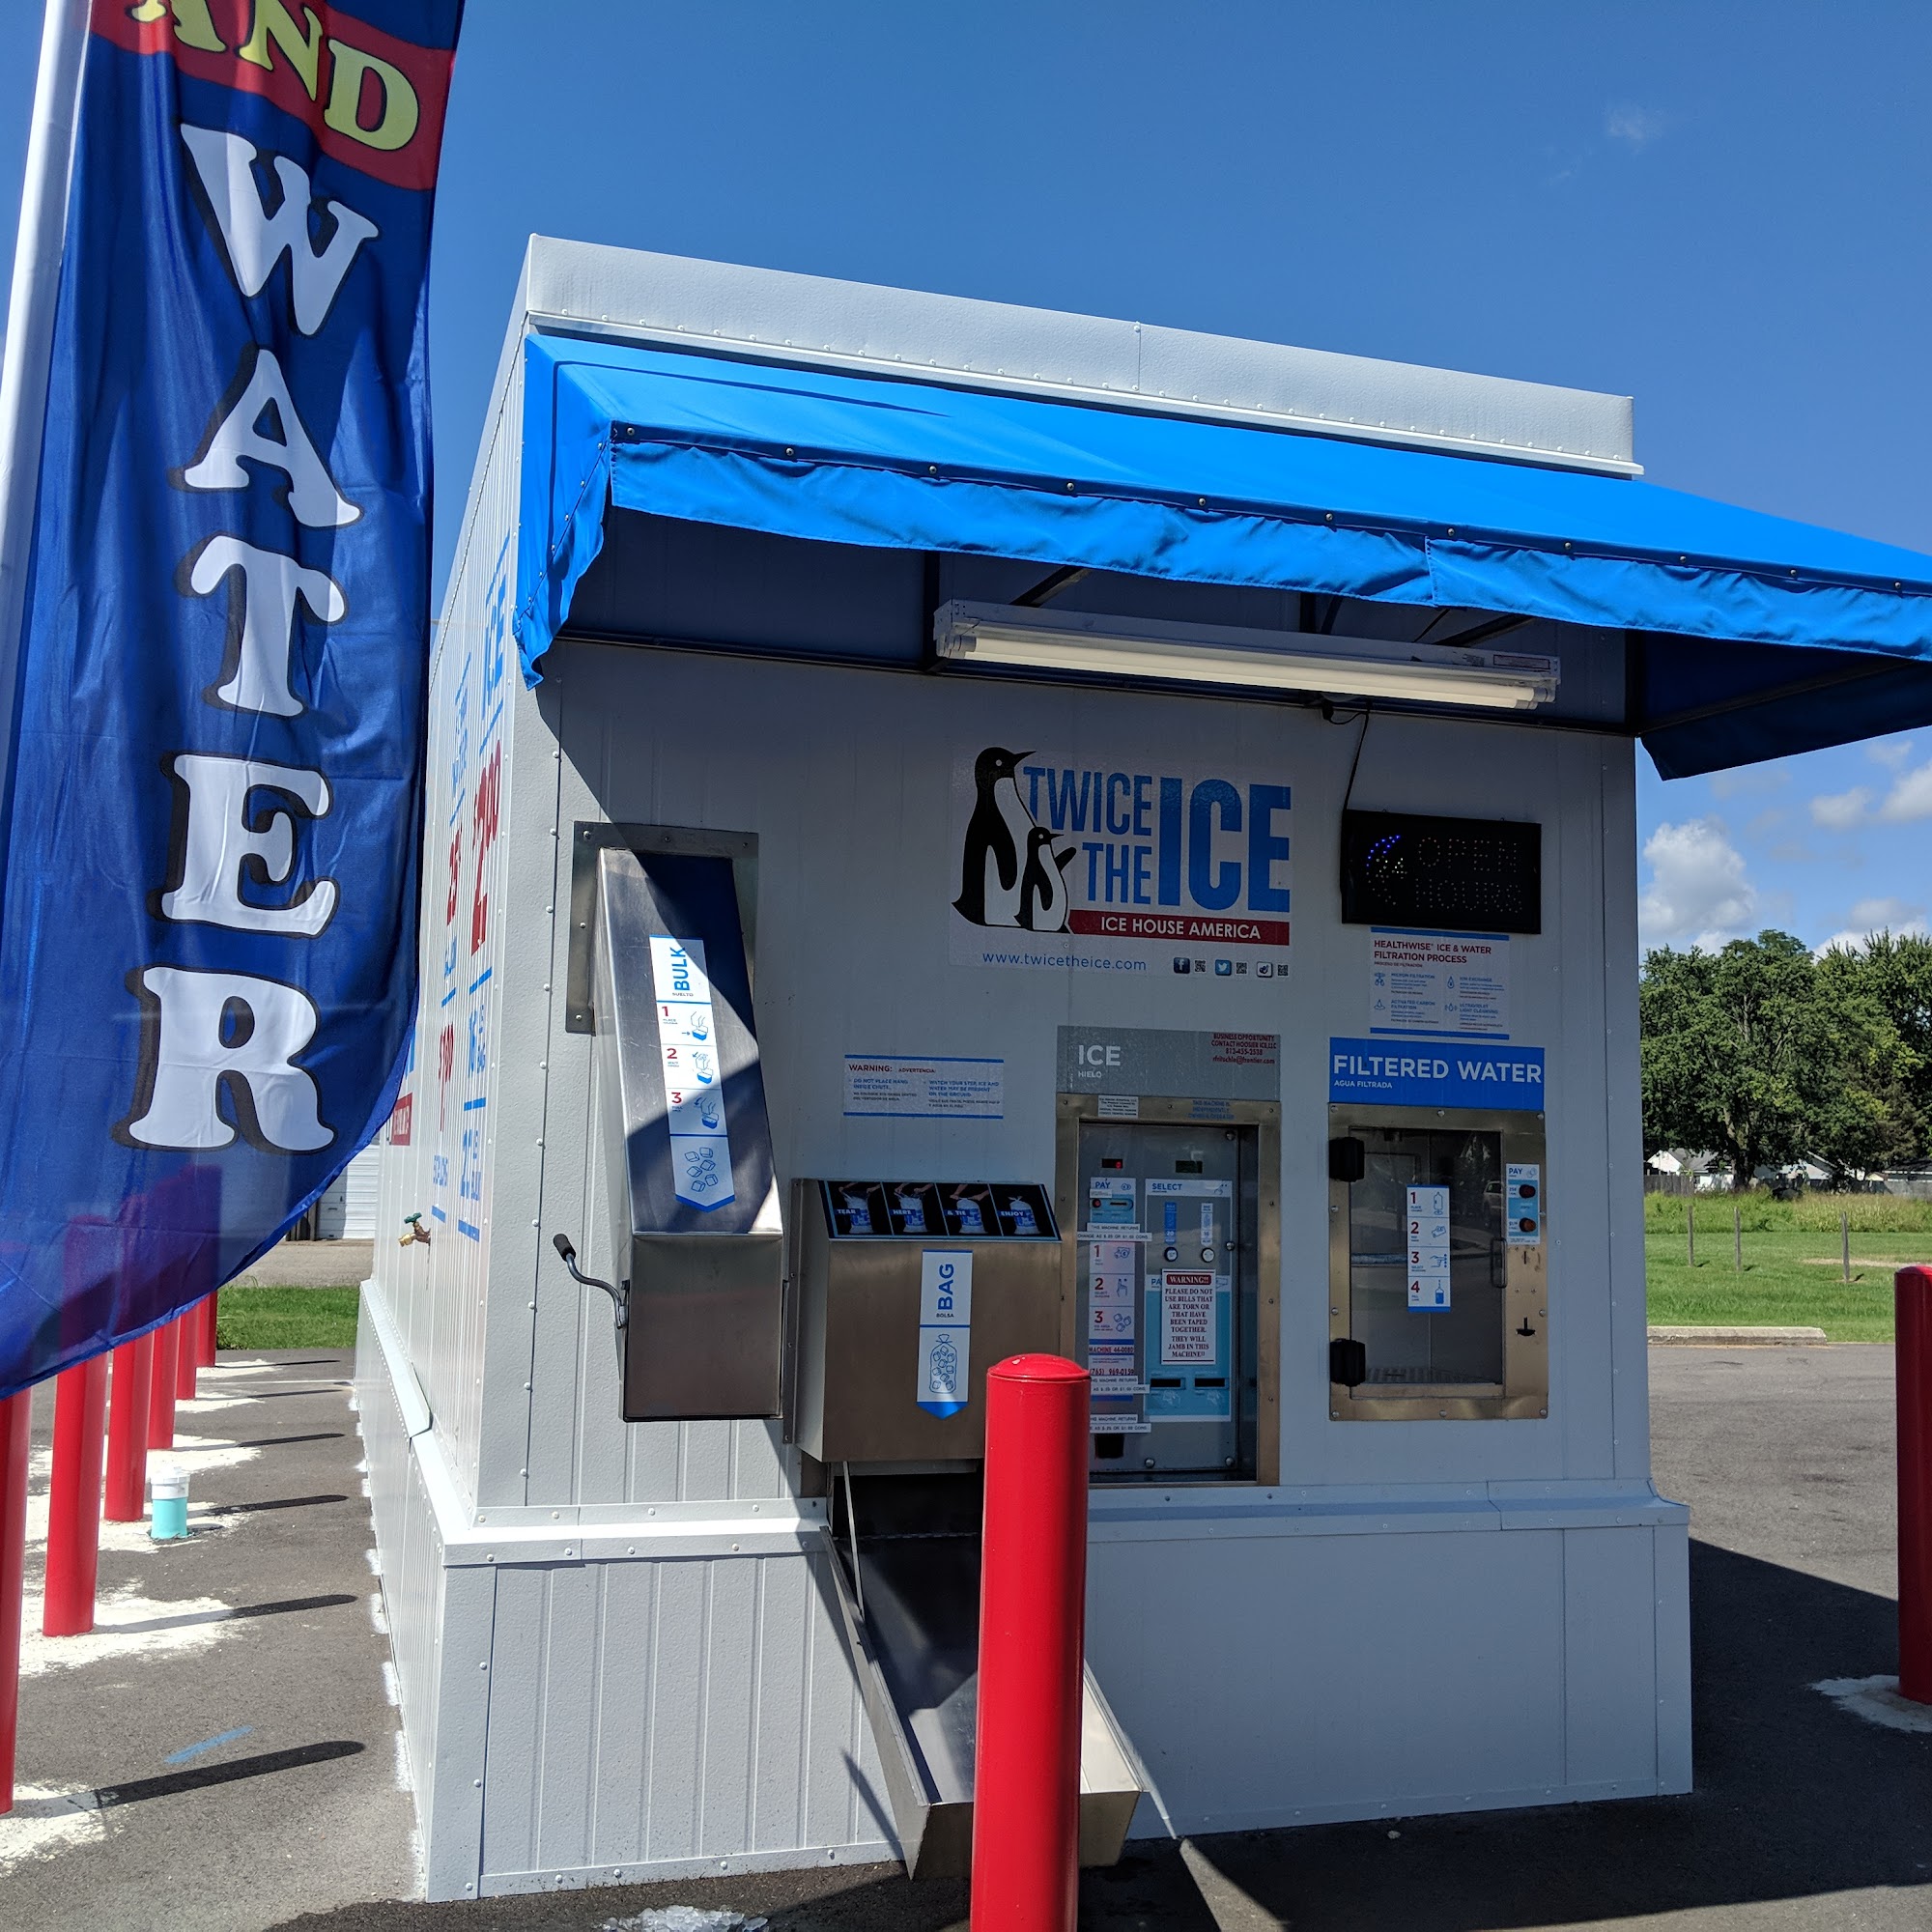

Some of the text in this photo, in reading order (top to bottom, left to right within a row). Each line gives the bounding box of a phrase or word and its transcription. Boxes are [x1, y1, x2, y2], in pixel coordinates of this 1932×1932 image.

[128, 124, 379, 1151] WATER
[1023, 766, 1292, 913] TWICE ICE
[1417, 837, 1518, 873] OPEN
[1082, 841, 1152, 904] THE
[1415, 878, 1523, 914] HOURS
[1100, 917, 1262, 940] ICE HOUSE AMERICA
[1436, 943, 1451, 952] ICE
[1453, 944, 1459, 952] &
[1461, 945, 1492, 954] WATER
[981, 952, 1147, 972] www.twicetheice.com
[1374, 952, 1467, 964] FILTRATION PROCESS
[669, 946, 691, 991] BULK
[662, 1006, 669, 1017] 1
[667, 1048, 678, 1060] 2
[1077, 1045, 1121, 1066] ICE
[849, 1064, 894, 1072] WARNING:
[1078, 1070, 1102, 1079] HIELO
[1333, 1054, 1542, 1083] FILTERED WATER
[1333, 1079, 1393, 1089] AGUA FILTRADA
[671, 1092, 683, 1104] 3
[1151, 1182, 1182, 1191] SELECT
[1410, 1191, 1416, 1205] 1
[1410, 1221, 1419, 1235] 2
[1094, 1244, 1100, 1258] 1
[1410, 1251, 1420, 1264] 3
[937, 1264, 954, 1311] BAG
[1094, 1277, 1104, 1291] 2
[1410, 1280, 1420, 1293] 4
[1094, 1310, 1103, 1323] 3
